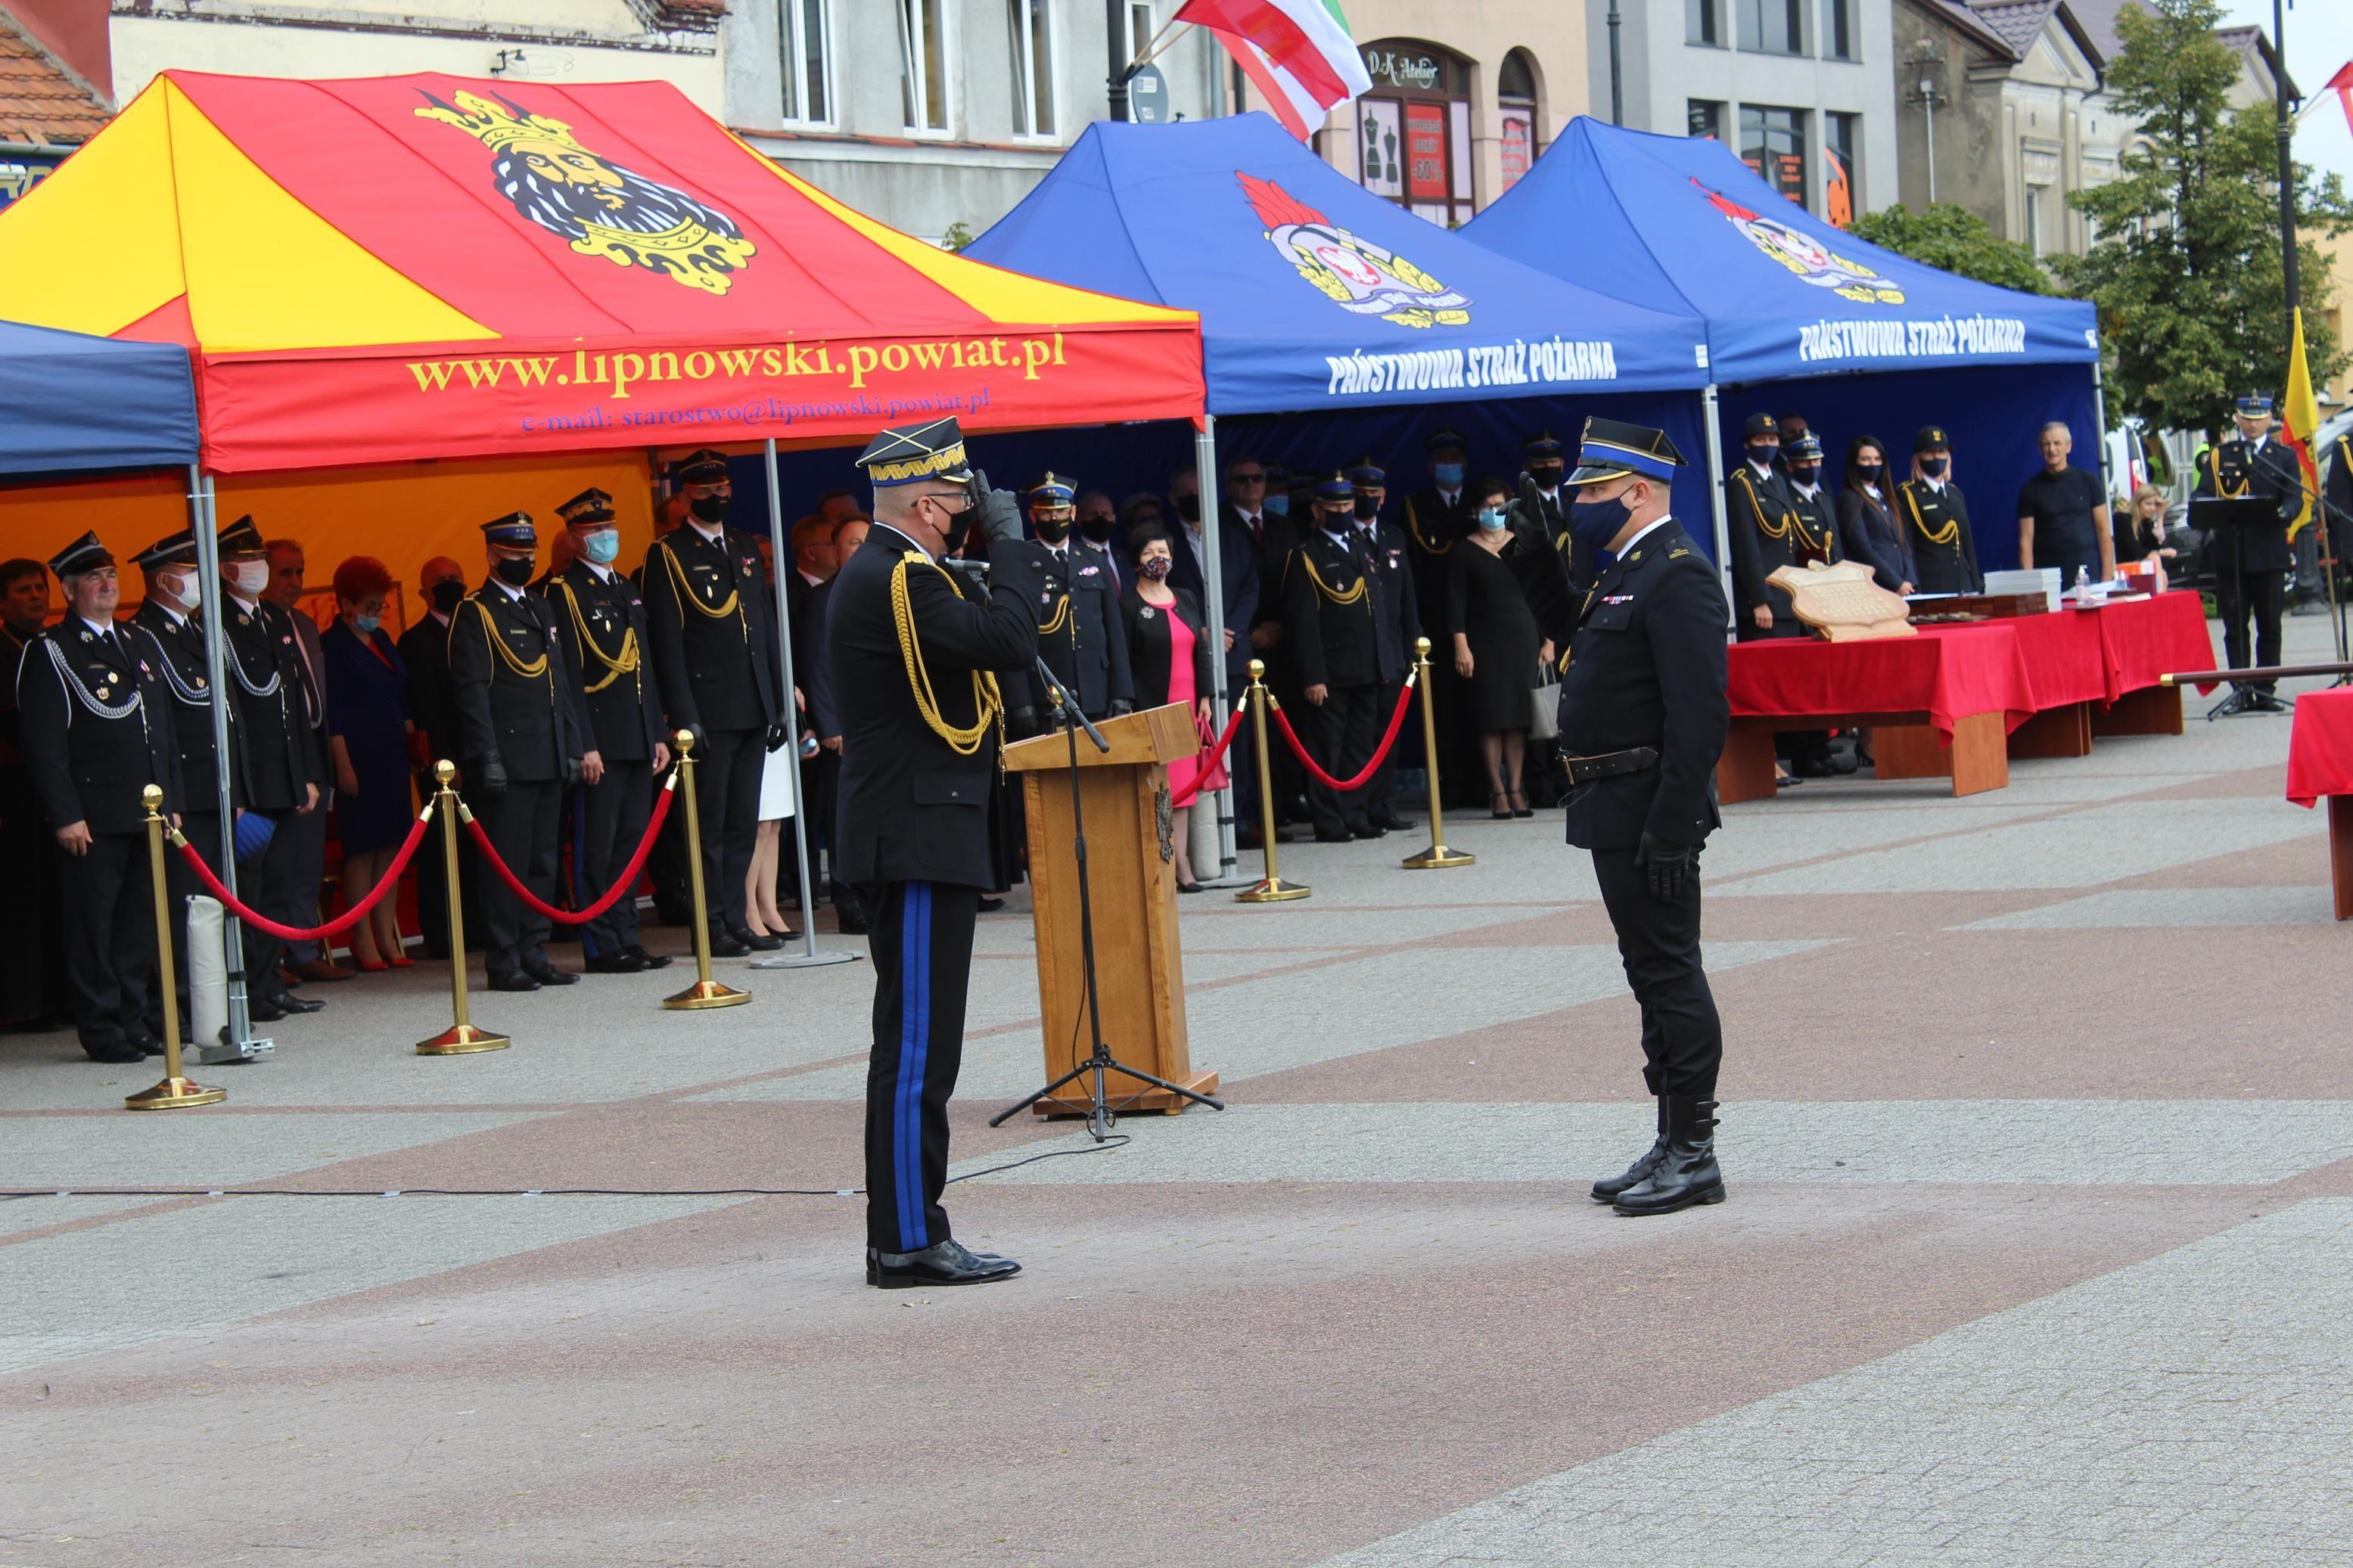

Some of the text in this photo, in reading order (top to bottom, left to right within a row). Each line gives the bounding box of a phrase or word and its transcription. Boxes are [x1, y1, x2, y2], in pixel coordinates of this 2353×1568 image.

[1399, 57, 1438, 89] Atelier
[406, 325, 1067, 399] www.lipnowski.powiat.pl
[1798, 312, 2026, 362] PAŃSTWOWA STRAŻ POŻARNA
[1325, 334, 1618, 395] PAŃSTWOWA STRAŻ POŻARNA
[521, 387, 990, 432] e-mail: starostwo@lipnowski.powiat.pl
